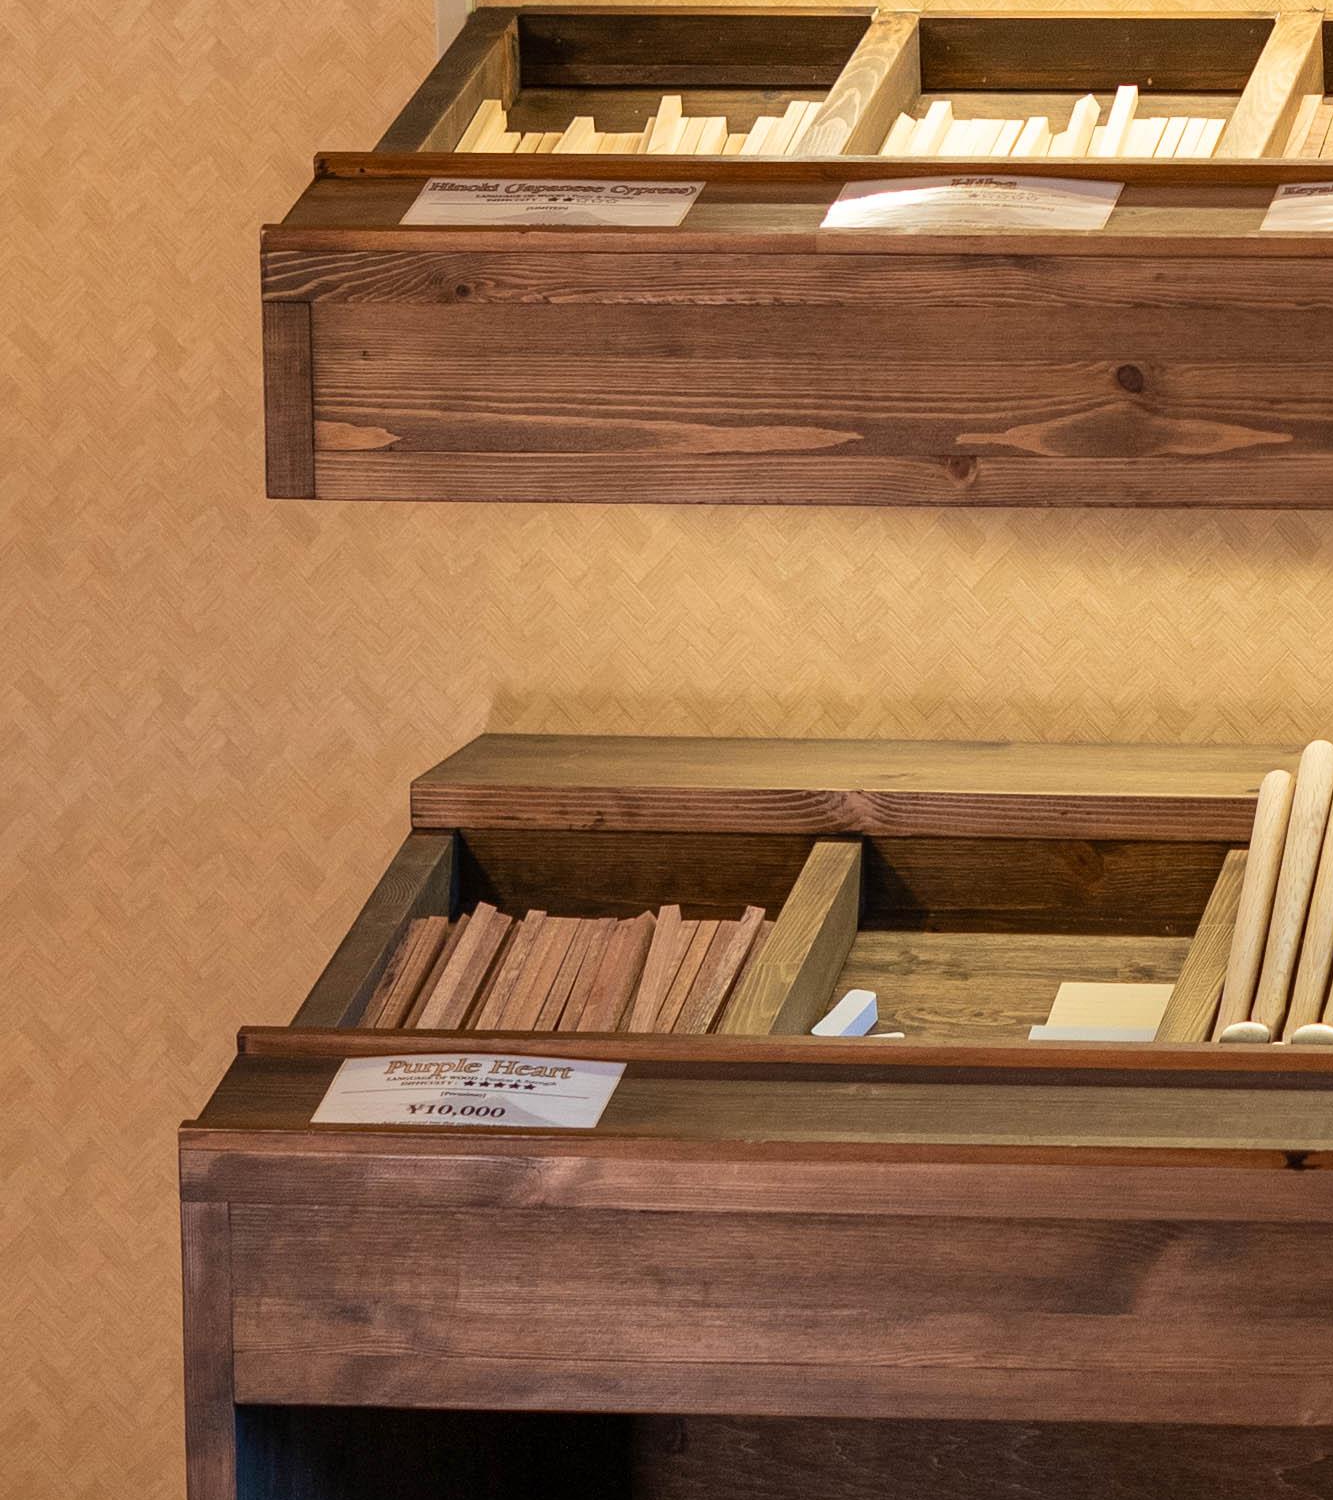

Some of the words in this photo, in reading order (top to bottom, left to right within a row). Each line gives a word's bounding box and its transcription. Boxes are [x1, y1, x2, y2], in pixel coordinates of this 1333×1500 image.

[428, 182, 499, 193] Hinoki
[505, 182, 606, 194] (Japanese
[610, 183, 696, 196] Cypress)
[384, 1058, 482, 1079] Purple
[488, 1060, 575, 1081] Heart
[407, 1103, 507, 1119] ¥10,000
